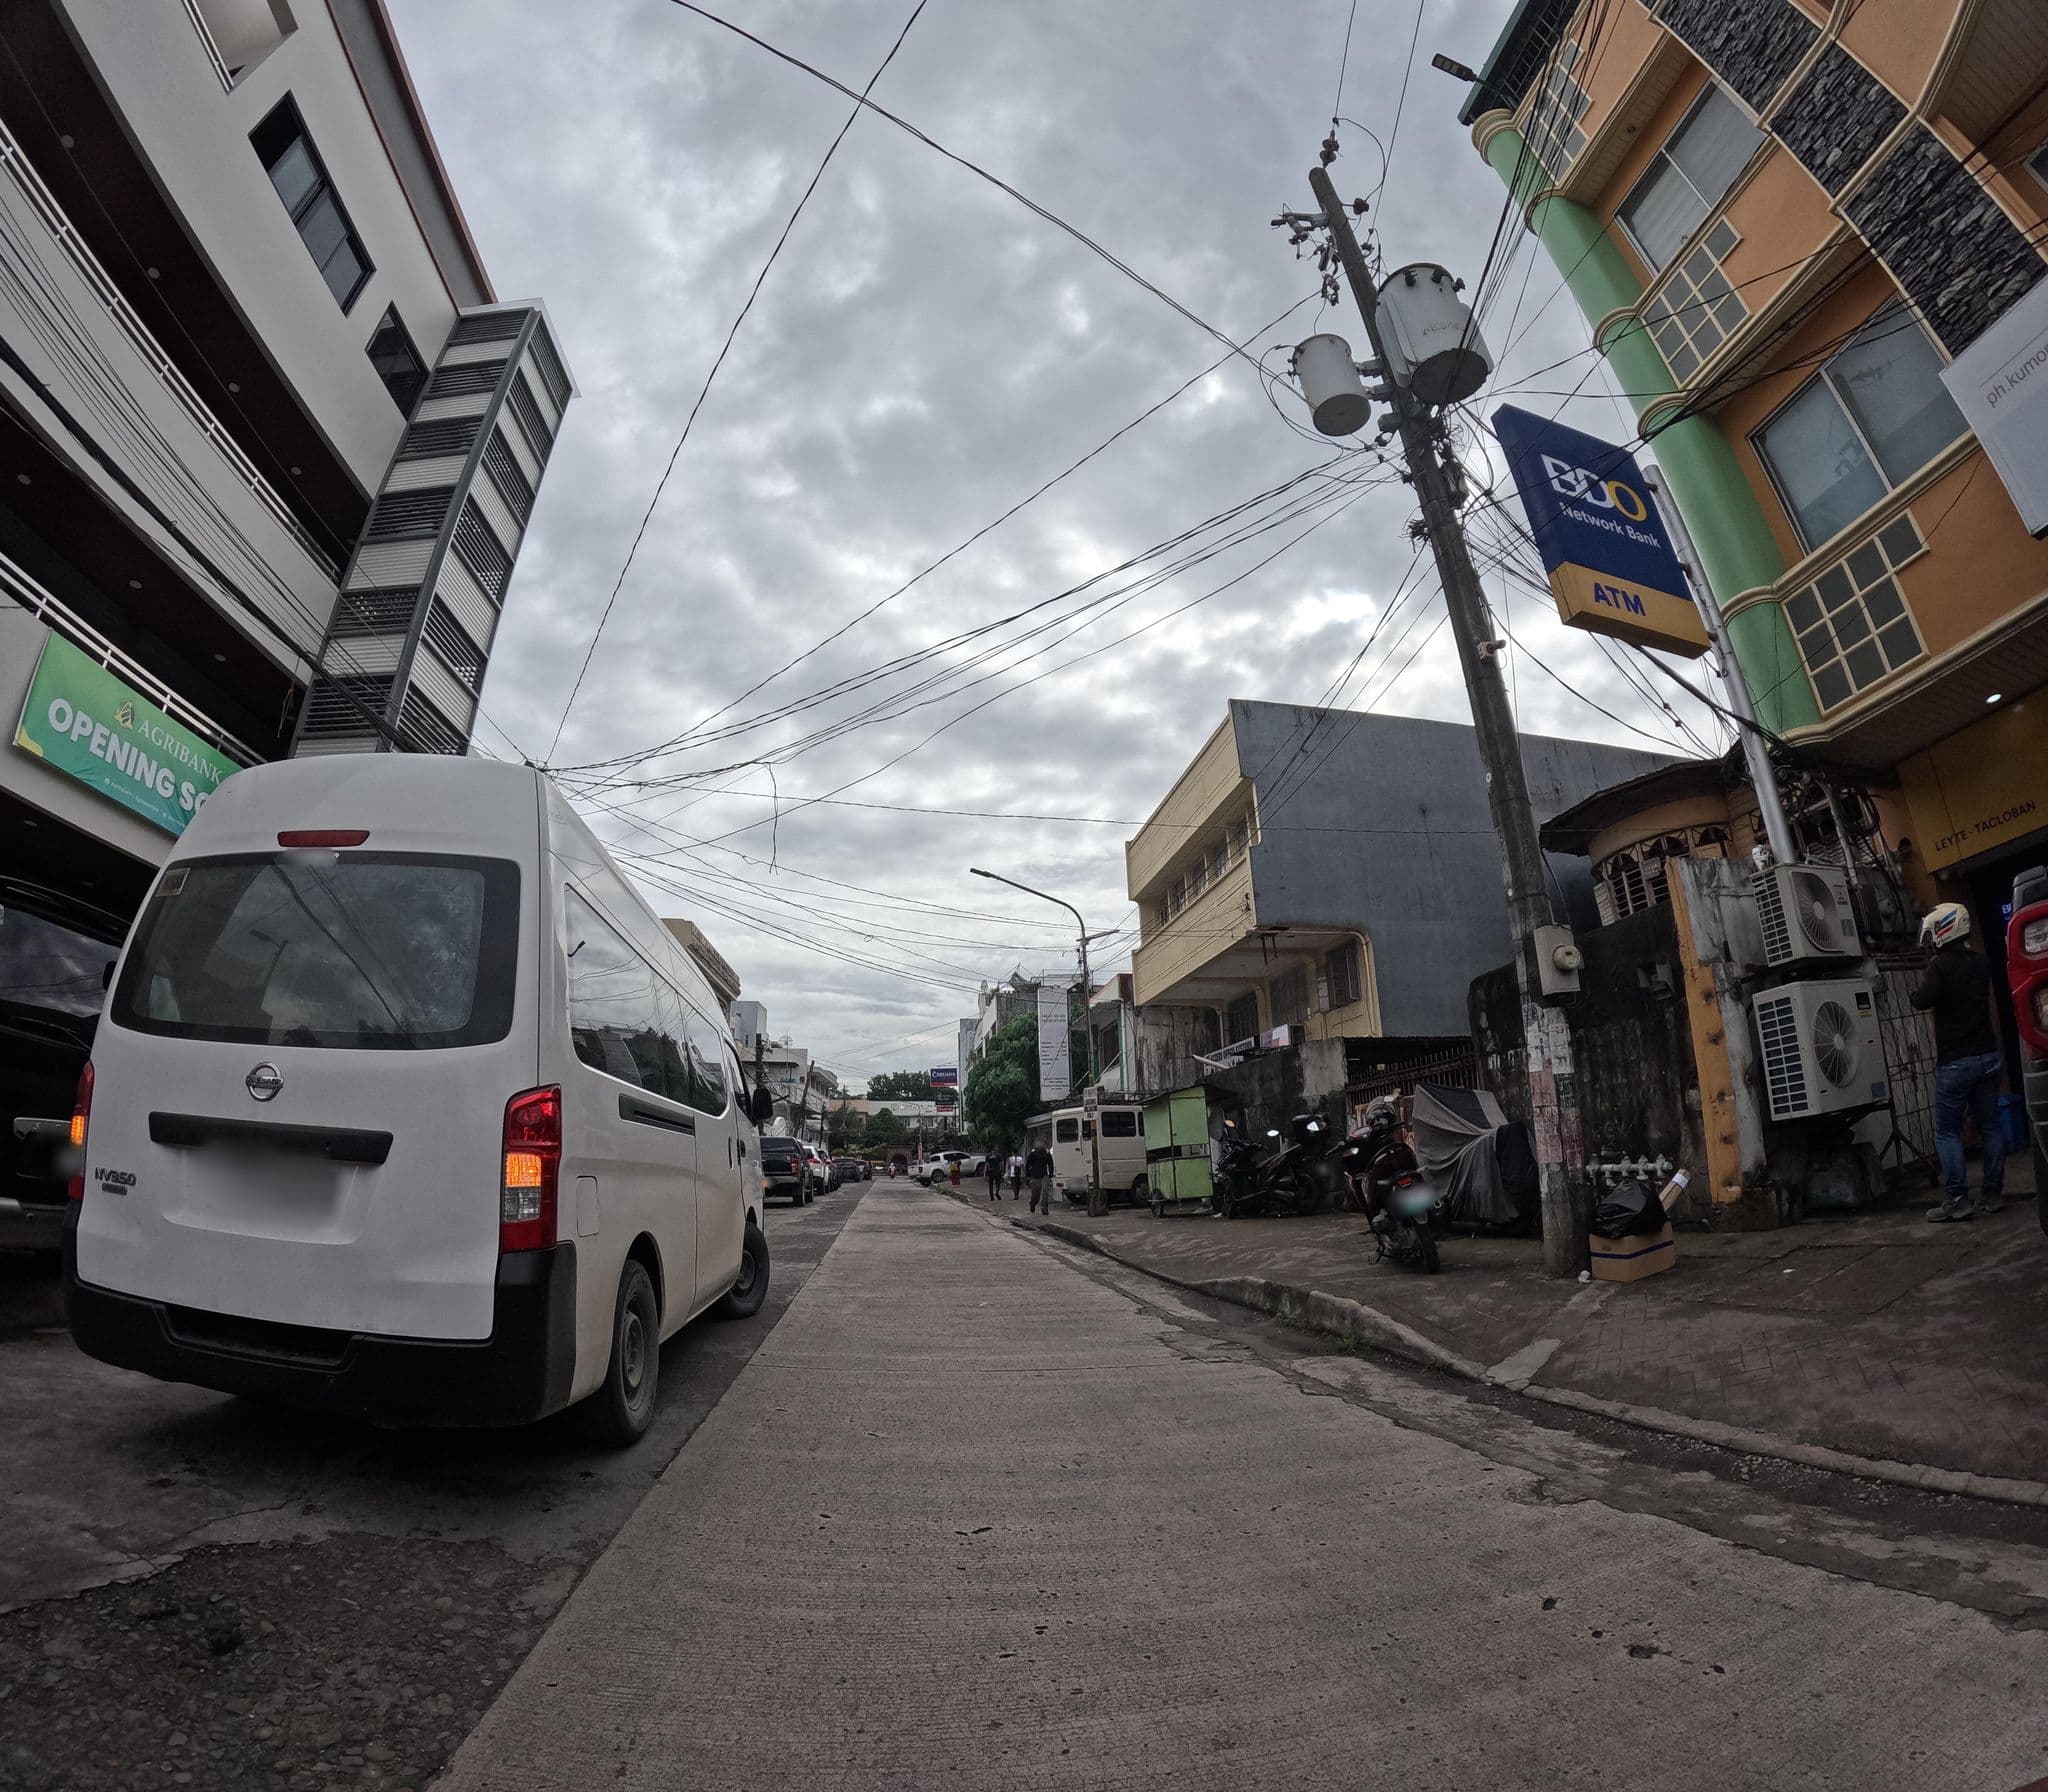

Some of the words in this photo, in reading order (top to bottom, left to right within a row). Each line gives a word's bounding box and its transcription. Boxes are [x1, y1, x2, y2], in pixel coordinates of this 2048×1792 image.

[1541, 453, 1648, 522] BDO
[1559, 501, 1624, 537] Network
[1625, 524, 1661, 549] Bank
[1592, 582, 1647, 617] ATM
[48, 698, 176, 799] OPENING
[137, 719, 223, 785] AGRIBANK
[1935, 831, 1968, 851] LEYTE
[1974, 800, 2036, 833] TACLOBAN
[95, 1167, 137, 1187] NV350
